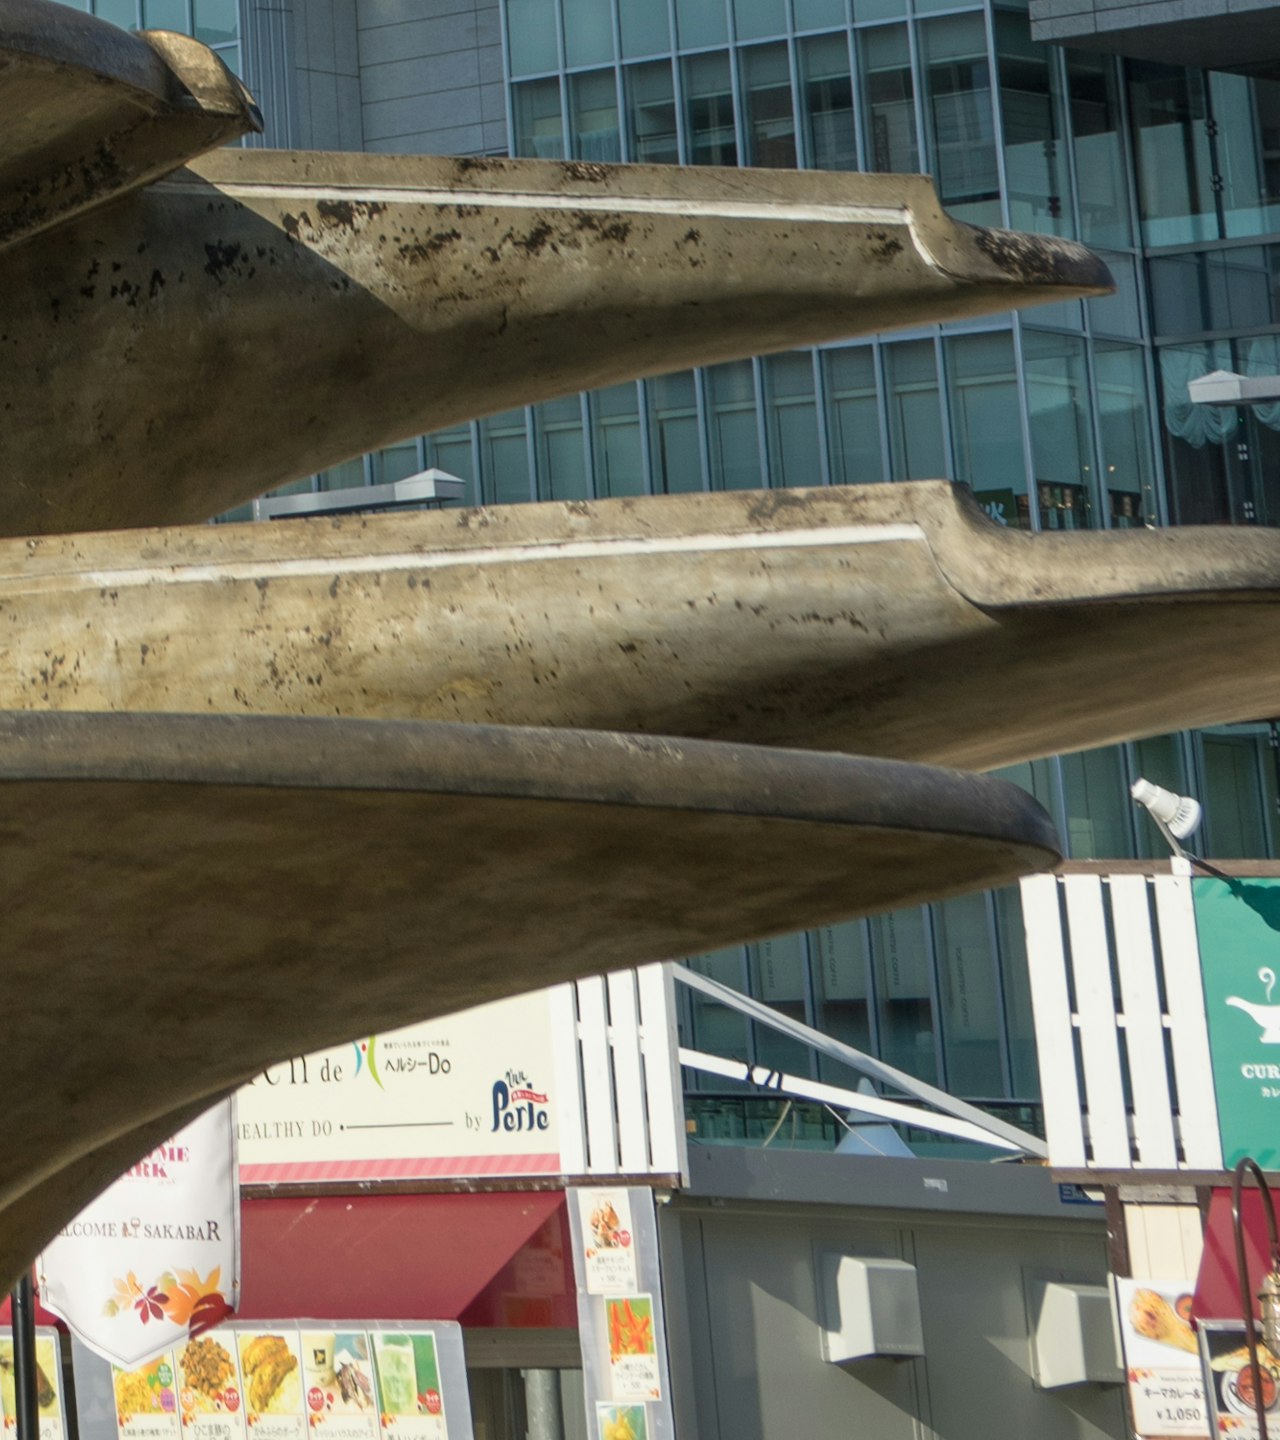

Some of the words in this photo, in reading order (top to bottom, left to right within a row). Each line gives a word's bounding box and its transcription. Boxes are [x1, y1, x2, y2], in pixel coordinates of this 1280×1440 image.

[321, 1058, 342, 1082] de
[385, 1052, 451, 1074] ヘルシーDo
[312, 1120, 333, 1136] DO
[465, 1112, 482, 1131] by
